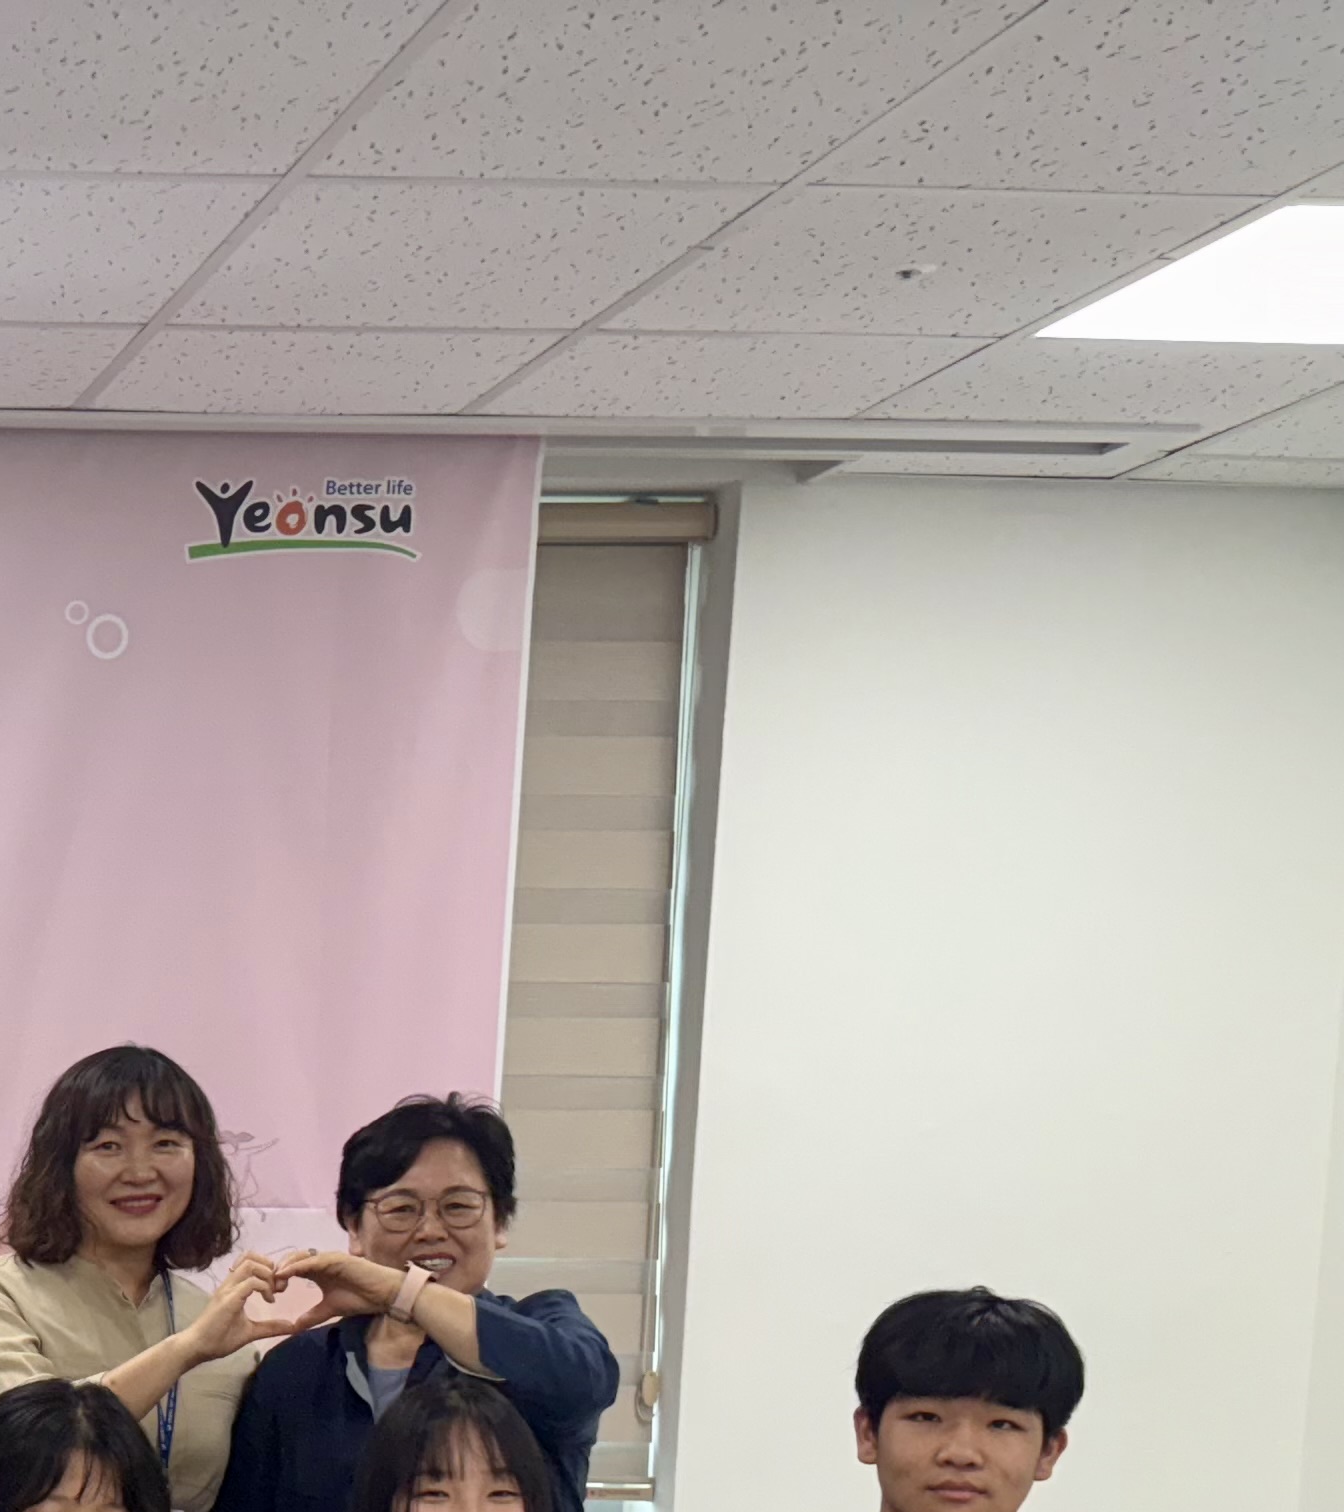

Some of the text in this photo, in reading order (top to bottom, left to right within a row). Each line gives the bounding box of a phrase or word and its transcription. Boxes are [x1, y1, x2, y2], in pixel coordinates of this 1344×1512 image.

[325, 480, 413, 495] Better life
[195, 480, 412, 548] Yeonsu
